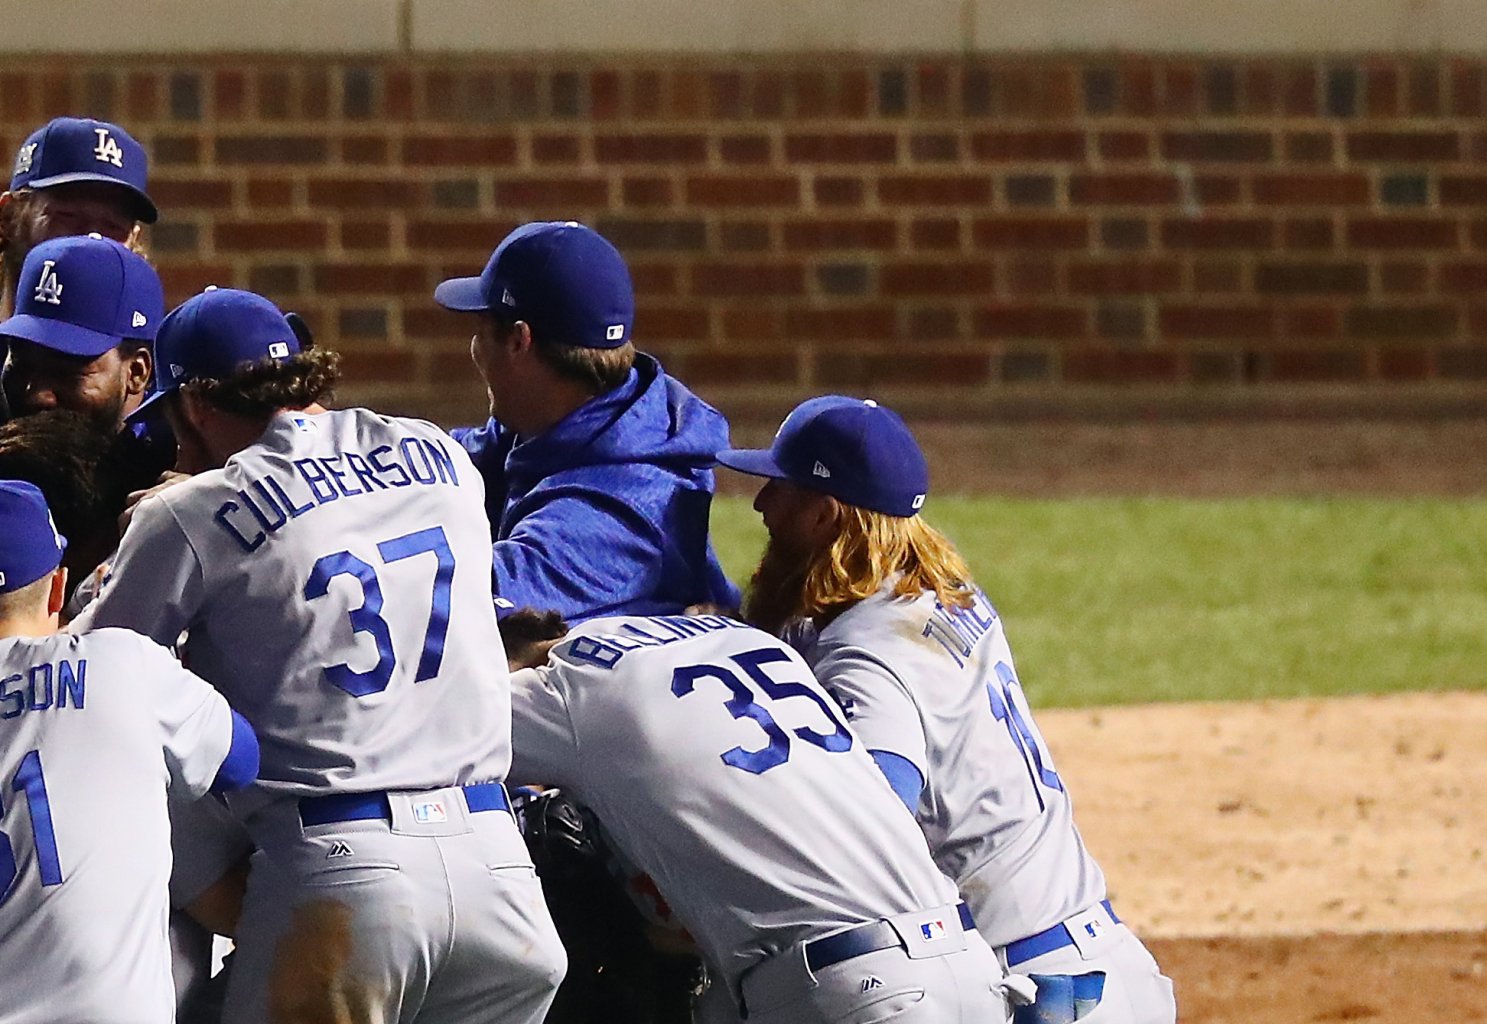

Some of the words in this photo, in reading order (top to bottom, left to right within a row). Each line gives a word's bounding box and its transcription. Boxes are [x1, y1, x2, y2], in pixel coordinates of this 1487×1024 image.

[94, 128, 123, 168] LA
[34, 260, 63, 305] LA
[214, 437, 460, 552] CULBERSON
[304, 525, 456, 698] 37
[670, 648, 853, 775] 35
